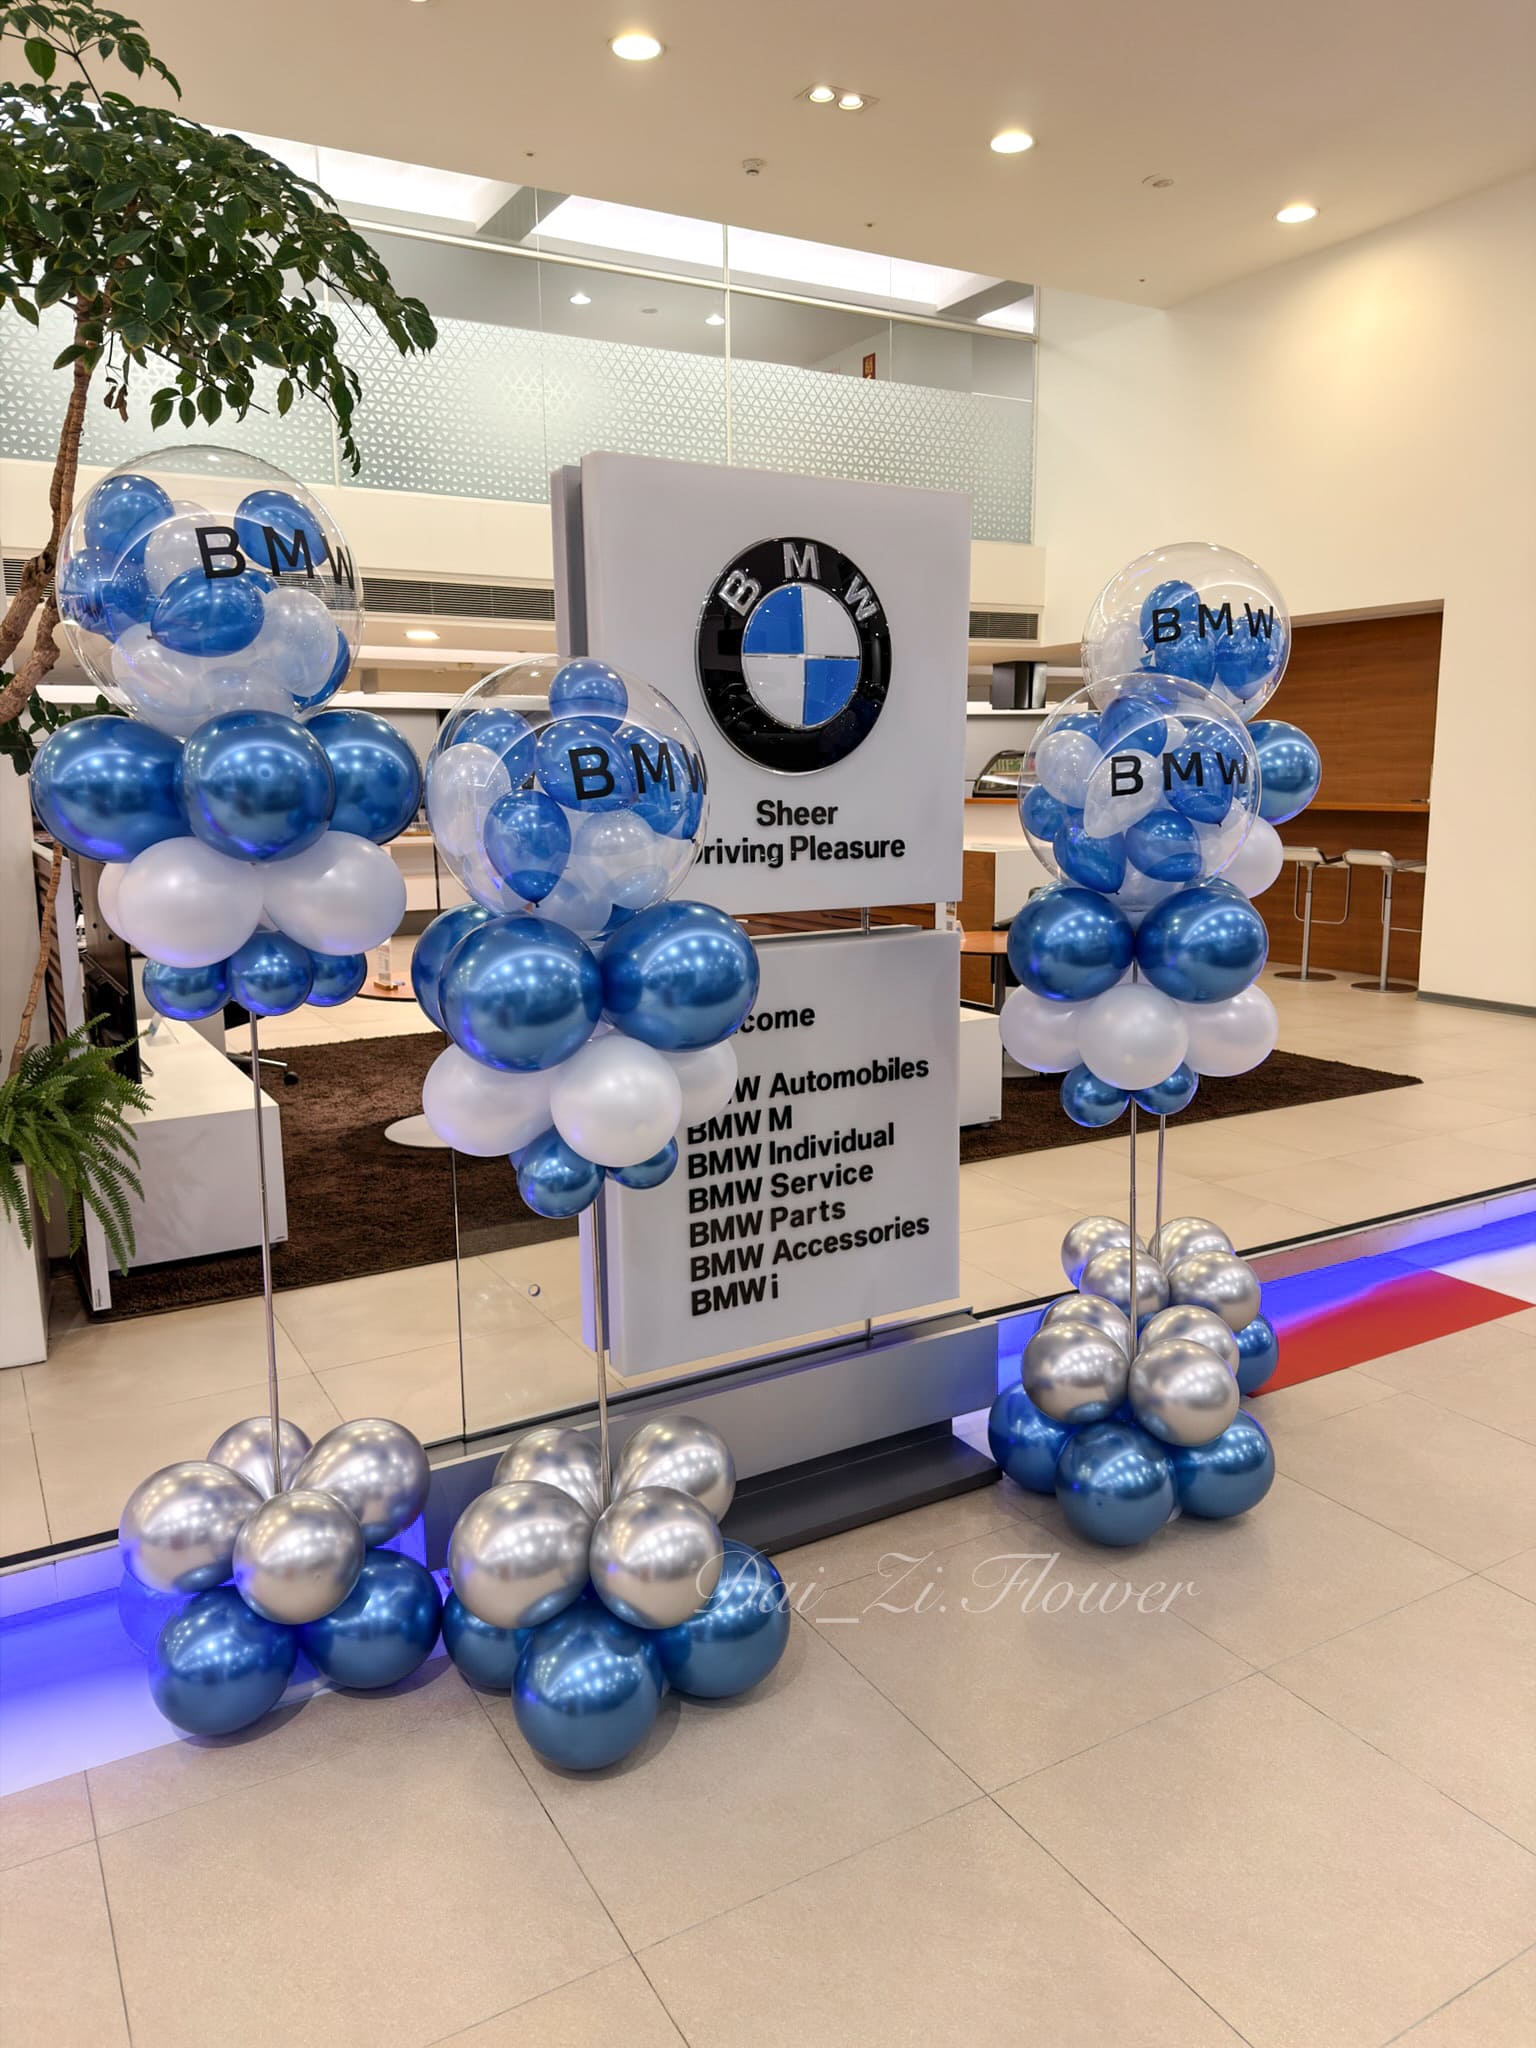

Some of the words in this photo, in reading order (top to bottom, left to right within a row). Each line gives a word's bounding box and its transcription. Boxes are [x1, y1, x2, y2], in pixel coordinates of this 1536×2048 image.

[195, 526, 355, 590] BMW
[718, 542, 880, 621] BMW
[1152, 602, 1274, 643] BMW
[568, 742, 708, 801] BMW
[1111, 751, 1249, 797] BMW
[756, 799, 838, 827] Sheer
[790, 835, 906, 861] Pleasure
[735, 1007, 815, 1035] come
[769, 1056, 929, 1099] Automobiles
[687, 1109, 761, 1146] BMW
[768, 1104, 793, 1133] M
[688, 1143, 762, 1180] BMW
[769, 1121, 895, 1166] Individual
[689, 1177, 763, 1214] BMW
[770, 1163, 874, 1199] Service
[689, 1210, 764, 1248] BMW
[770, 1200, 846, 1233] Parts
[690, 1243, 764, 1282] BMW
[772, 1215, 930, 1266] Accessories
[691, 1275, 767, 1317] BMW
[771, 1273, 779, 1300] i
